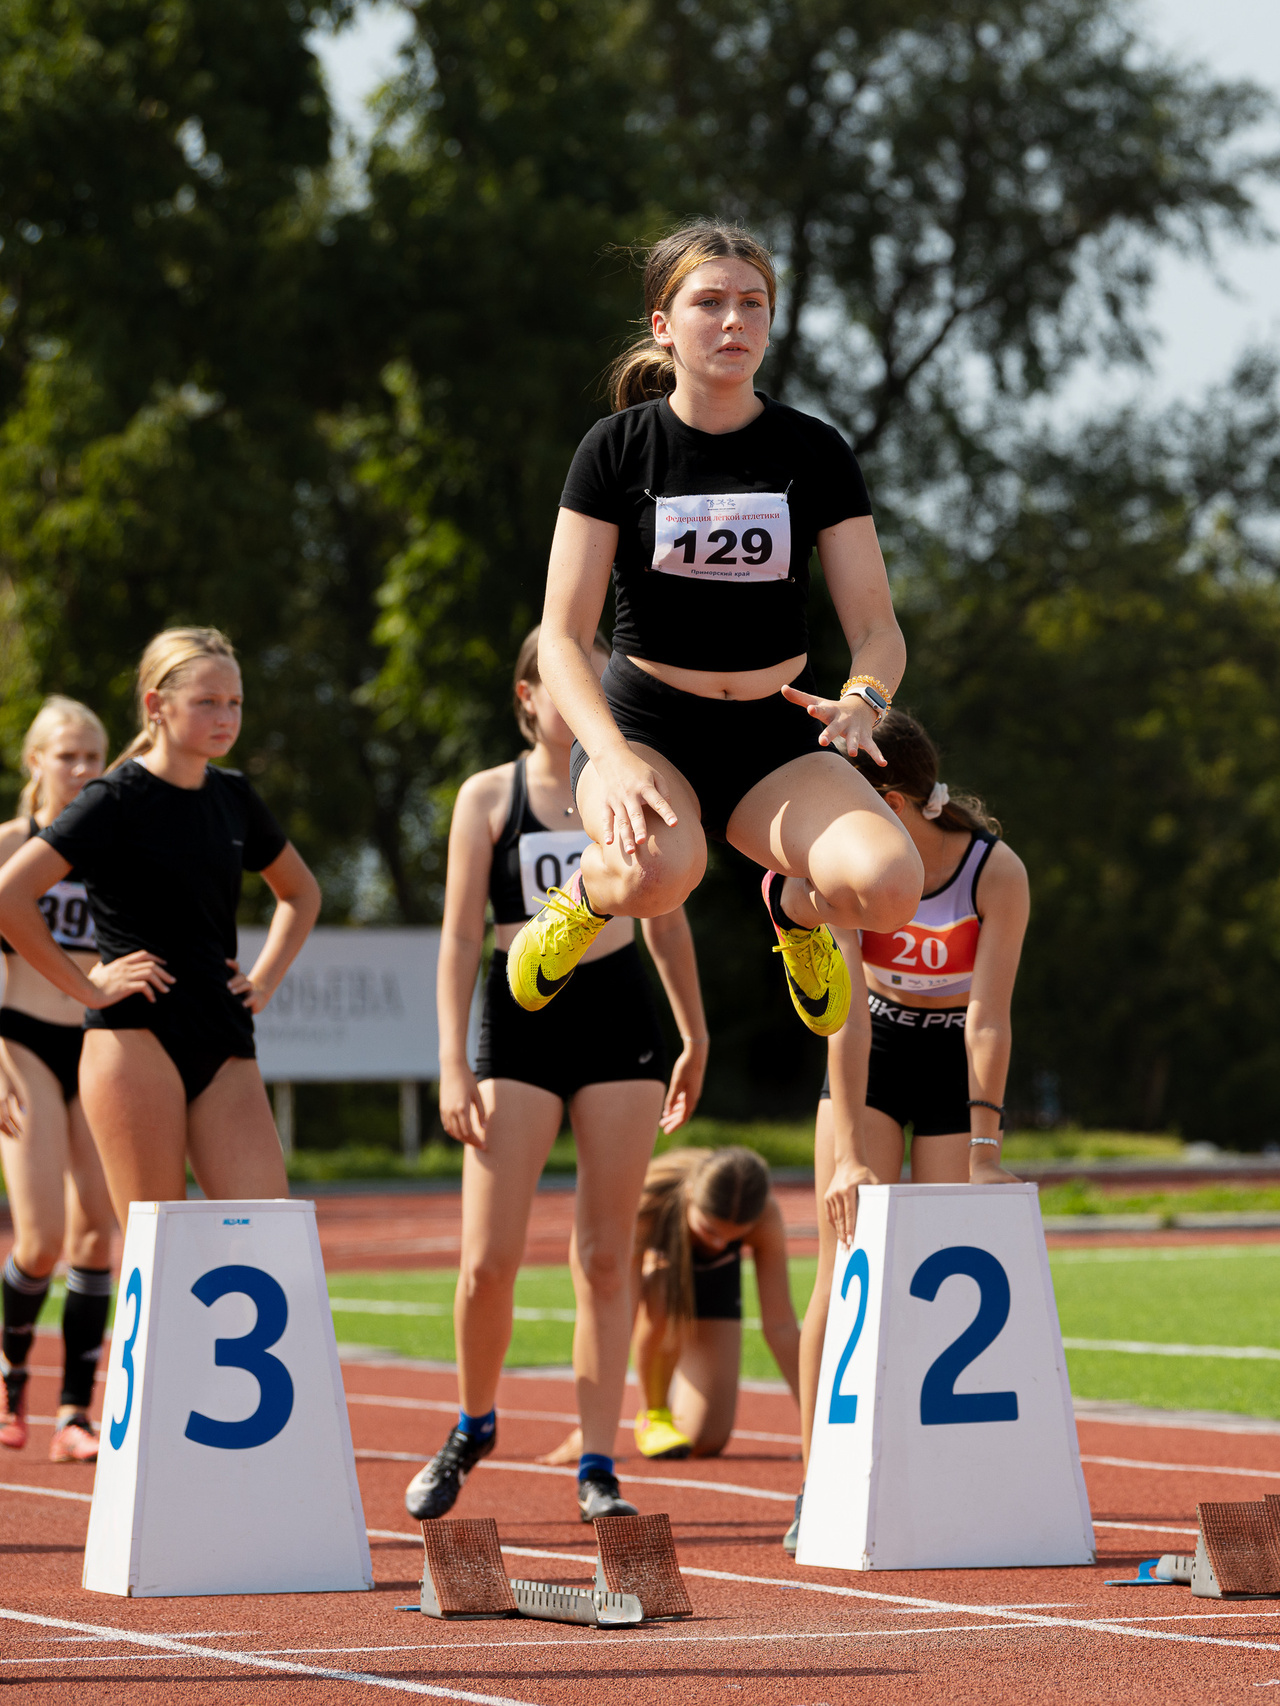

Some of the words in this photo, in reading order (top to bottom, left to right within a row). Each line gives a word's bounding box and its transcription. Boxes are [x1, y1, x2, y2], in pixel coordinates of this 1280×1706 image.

[665, 514, 712, 524] Федерация
[741, 512, 780, 521] атлетики
[673, 527, 773, 565] 129
[691, 569, 733, 577] Приморский
[891, 930, 948, 969] 20
[922, 1012, 967, 1028] PR
[828, 1248, 869, 1424] 2
[909, 1246, 1019, 1425] 2
[109, 1267, 142, 1450] 3
[184, 1264, 294, 1450] 3
